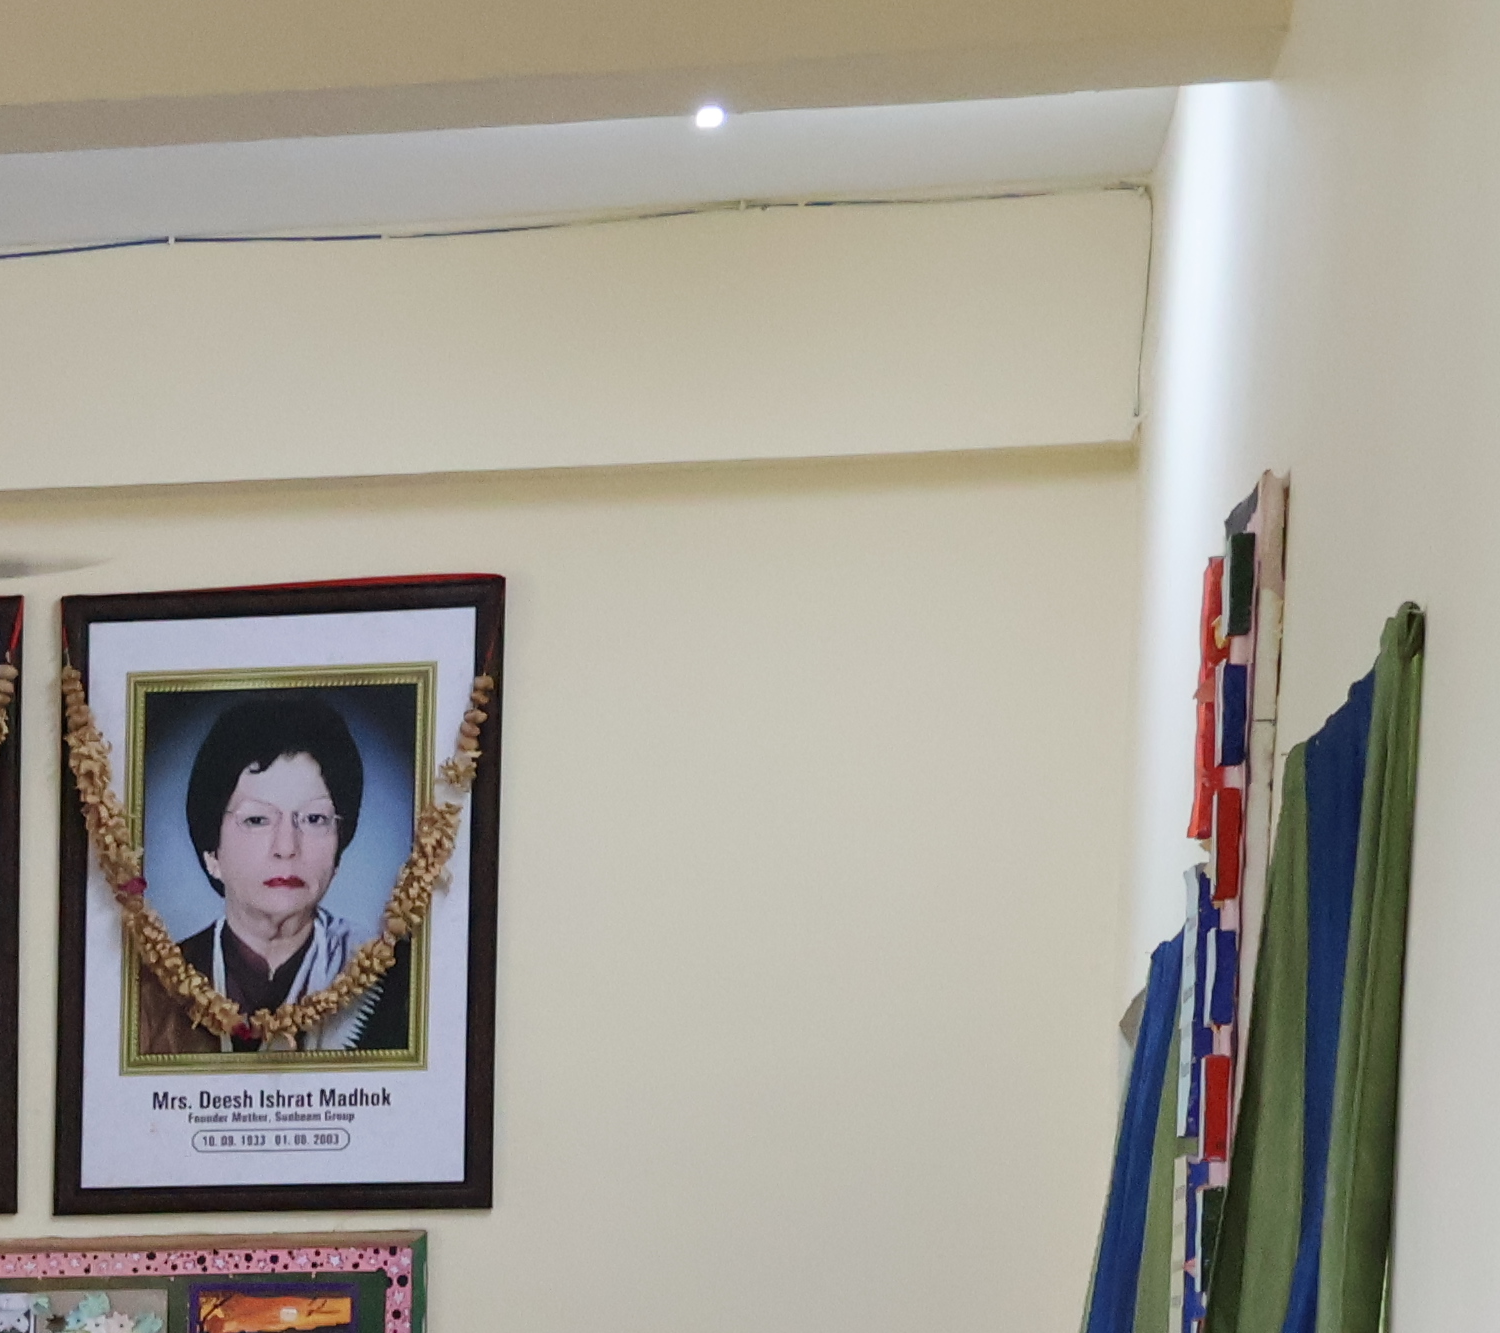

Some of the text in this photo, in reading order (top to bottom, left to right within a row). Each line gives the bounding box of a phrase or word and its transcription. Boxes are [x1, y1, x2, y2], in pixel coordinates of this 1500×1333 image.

[152, 1087, 391, 1110] Mrs. Deesh Ishrat Madhok
[188, 1110, 356, 1123] Founder Mother, Sunbeam Group
